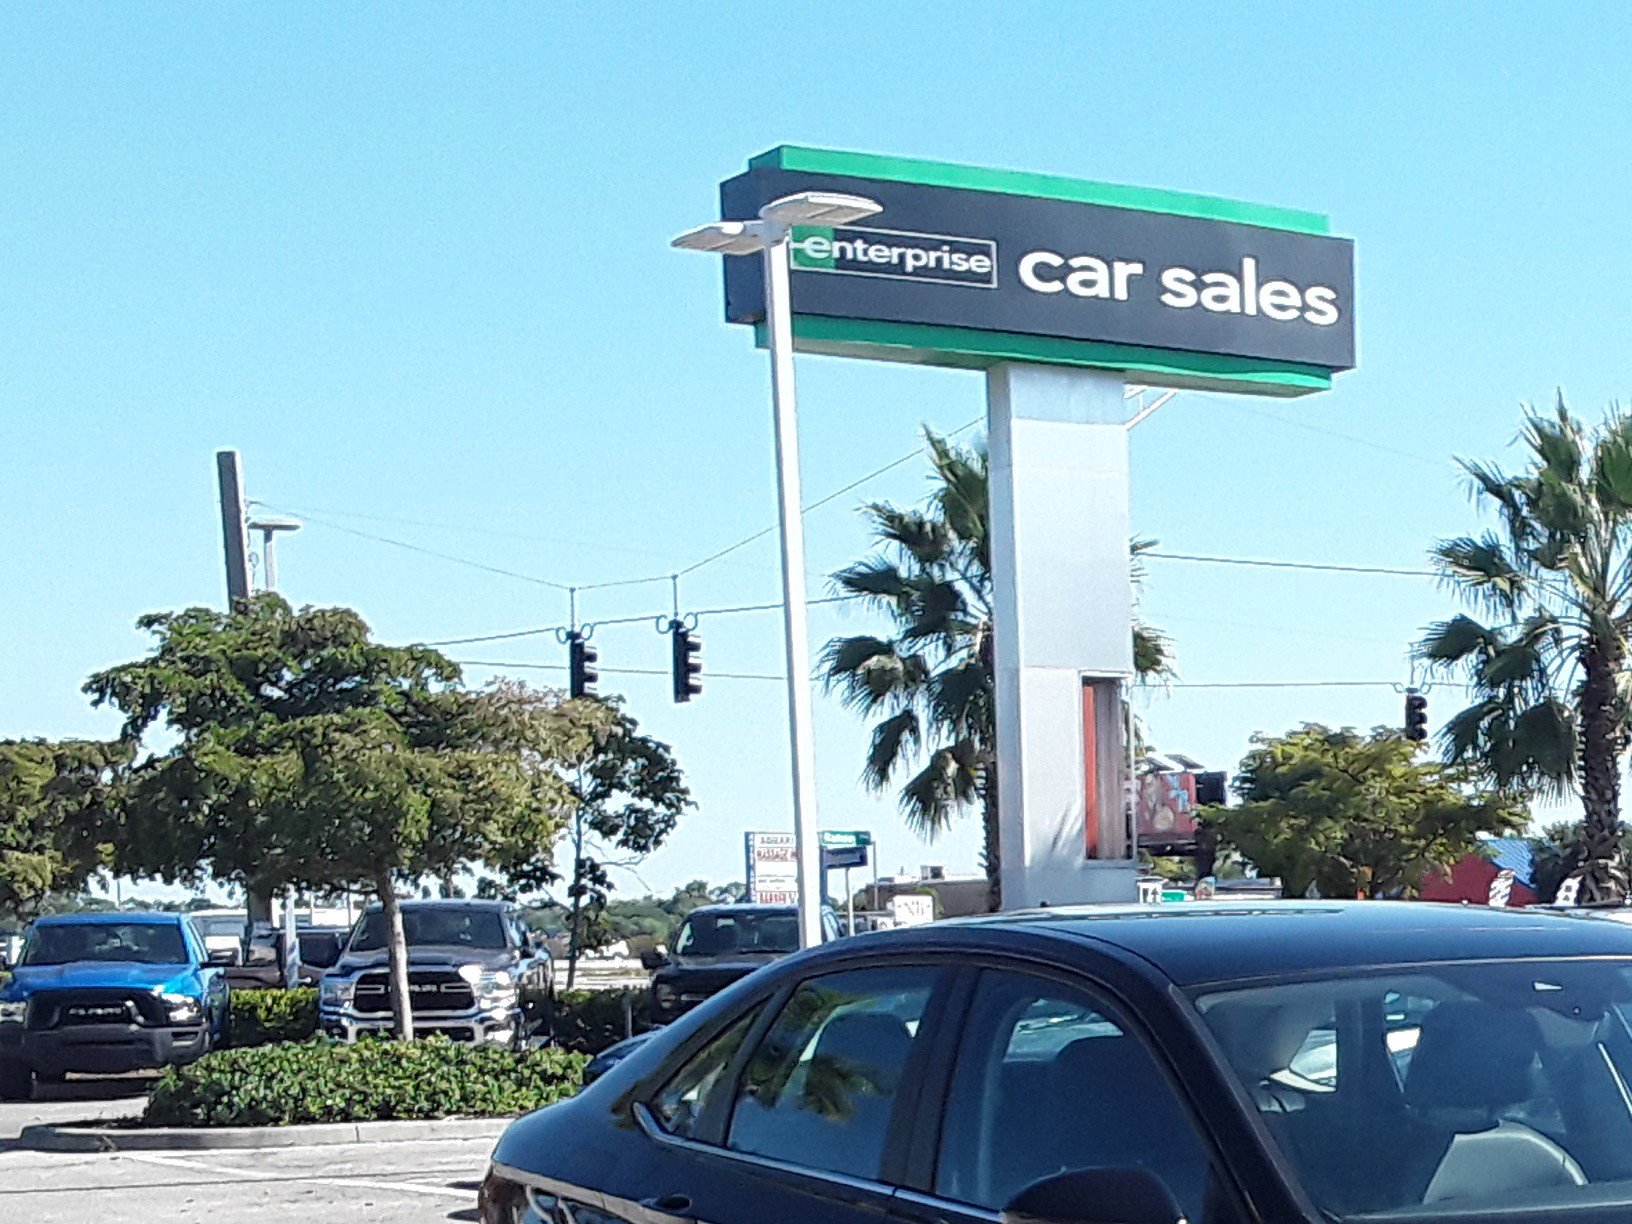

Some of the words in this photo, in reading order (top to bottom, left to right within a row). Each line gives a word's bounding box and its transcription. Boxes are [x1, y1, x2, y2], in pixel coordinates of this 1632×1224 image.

[796, 236, 991, 273] enterprise
[1018, 250, 1144, 300] car
[1159, 256, 1339, 326] sales
